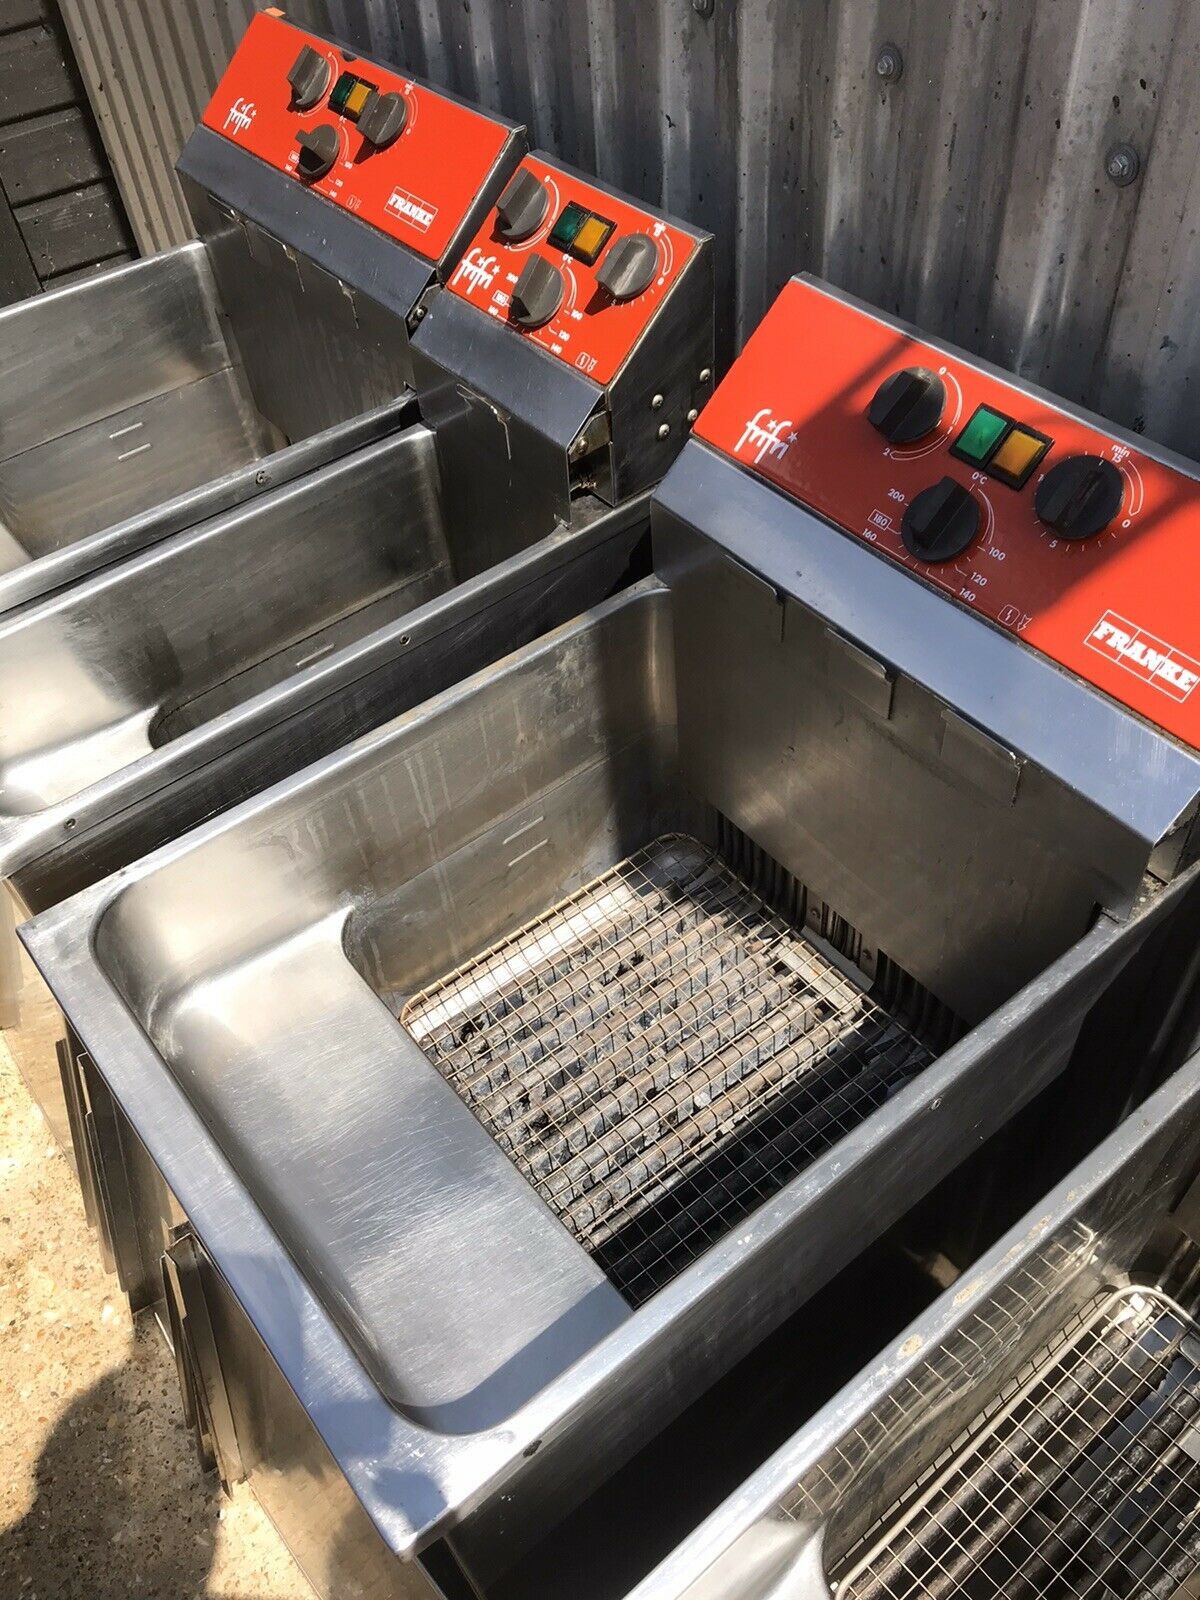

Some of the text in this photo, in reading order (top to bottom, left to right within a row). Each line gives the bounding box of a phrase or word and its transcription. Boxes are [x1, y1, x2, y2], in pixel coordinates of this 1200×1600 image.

[1111, 445, 1131, 458] min
[1112, 453, 1122, 463] 15
[887, 488, 905, 502] 200
[872, 512, 888, 527] 180
[1122, 519, 1131, 528] 0
[862, 528, 878, 542] 160
[1049, 540, 1058, 548] 5
[988, 547, 1006, 561] 100
[971, 572, 988, 587] 120
[959, 588, 976, 602] 140
[1092, 620, 1199, 692] FRANKE
